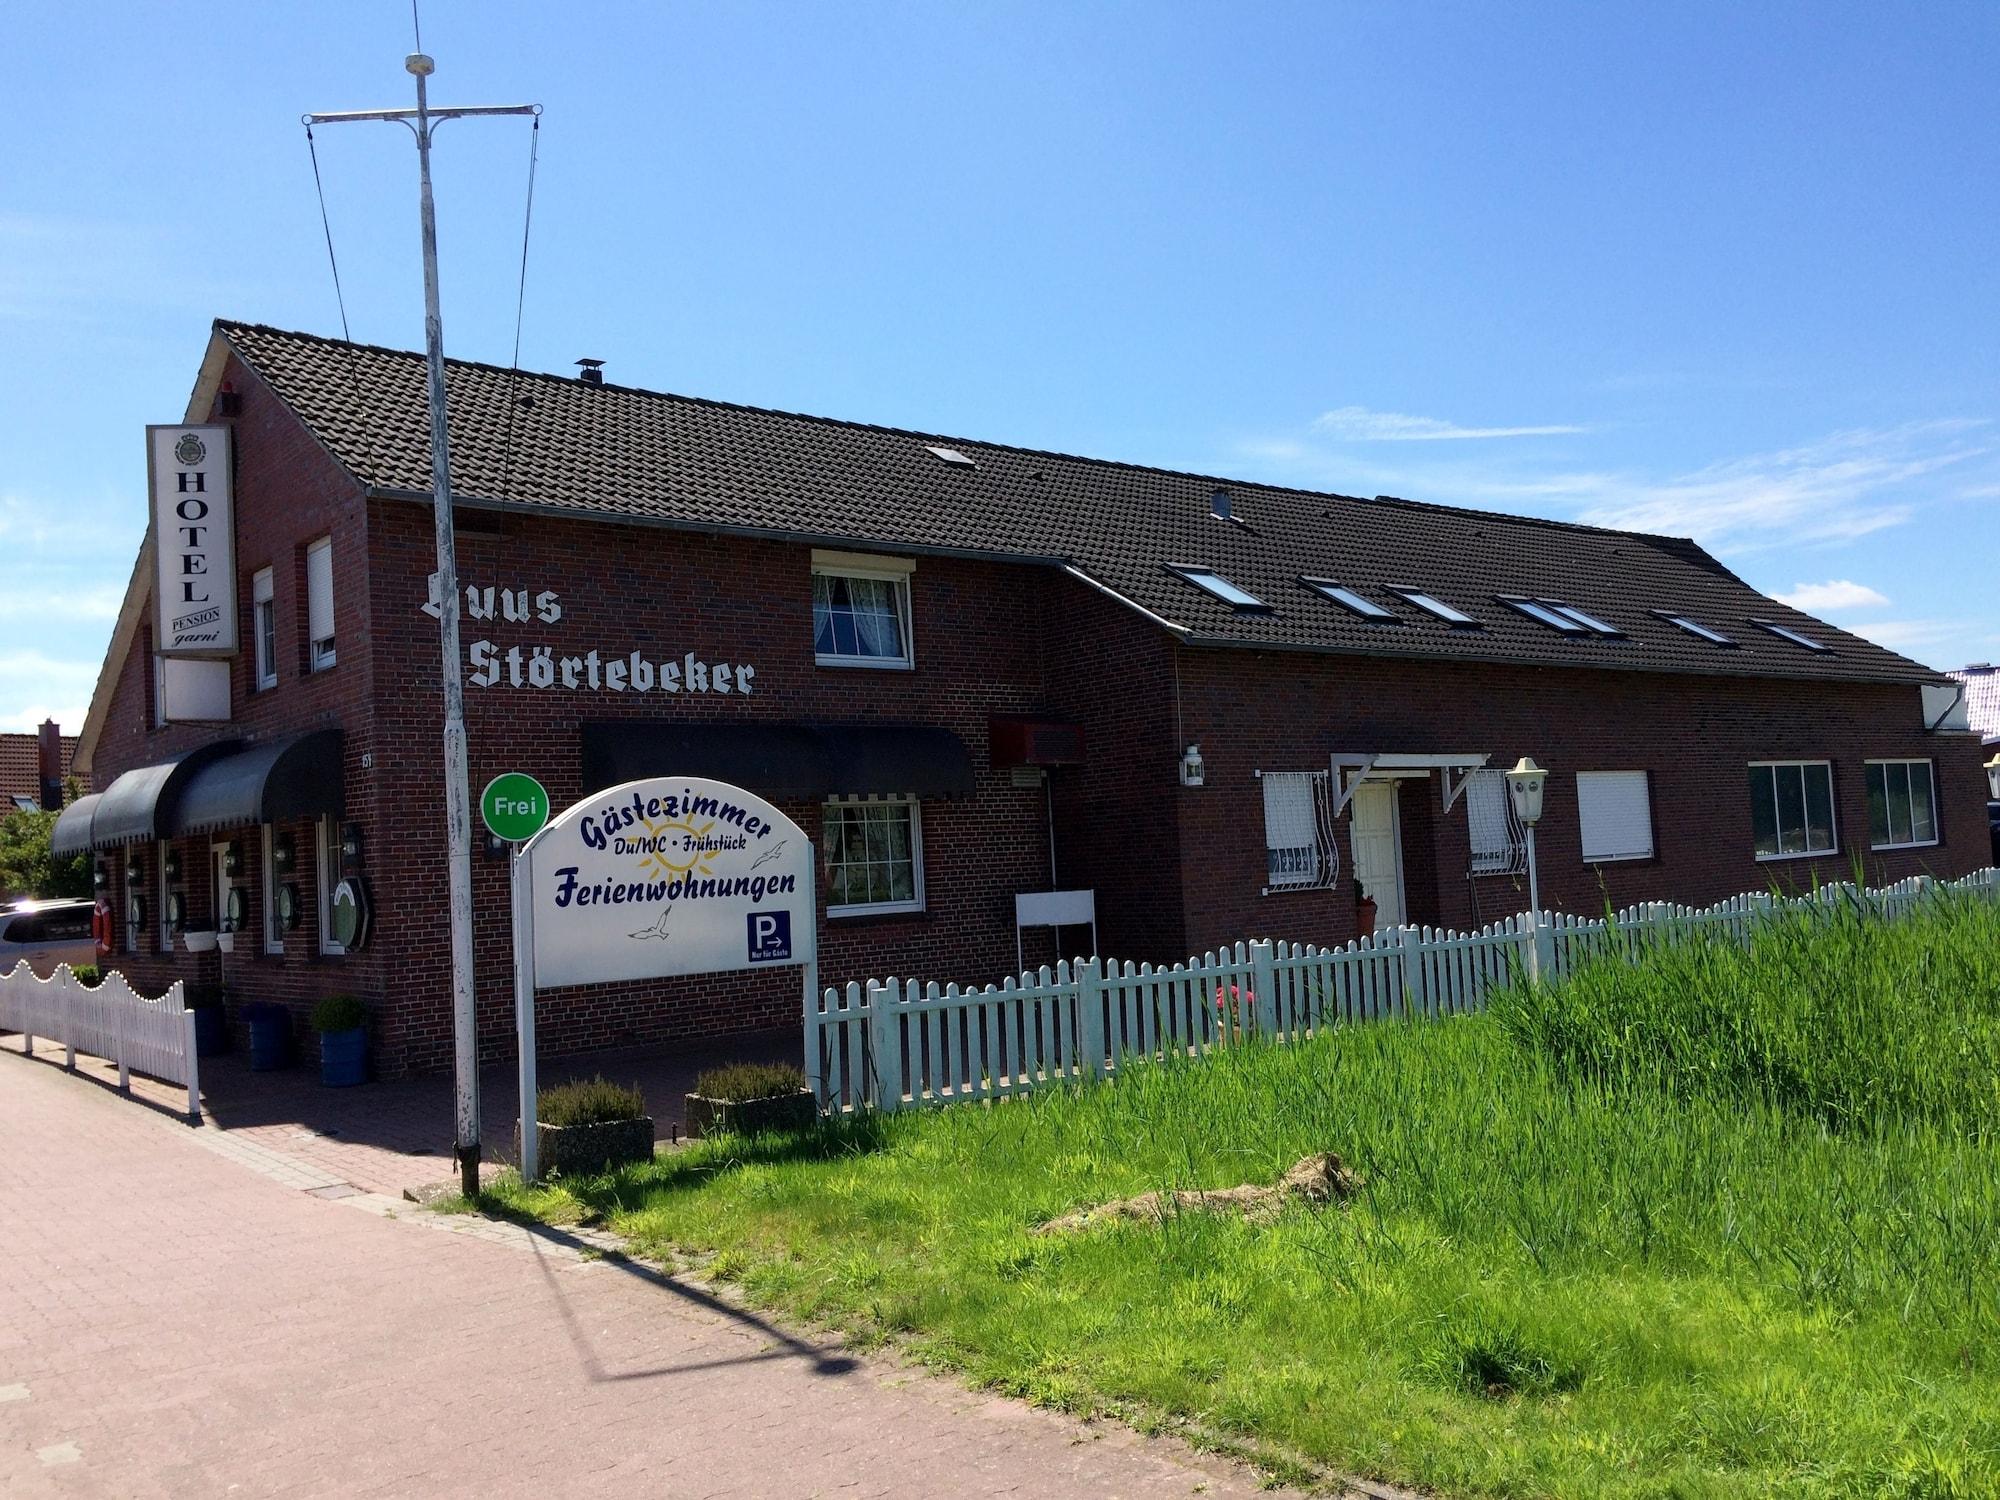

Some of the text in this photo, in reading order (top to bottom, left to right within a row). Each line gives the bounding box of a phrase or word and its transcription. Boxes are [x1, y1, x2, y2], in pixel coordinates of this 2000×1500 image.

[175, 472, 209, 602] HOTEL
[172, 608, 221, 631] PENSION
[172, 630, 219, 647] garni
[469, 639, 756, 695] Störtebeker
[494, 797, 537, 816] Frei
[580, 788, 772, 850] Gästezimmer
[614, 833, 747, 855] Du/WC Frühstück
[554, 866, 796, 907] Ferienwohnungen
[756, 915, 777, 949] P
